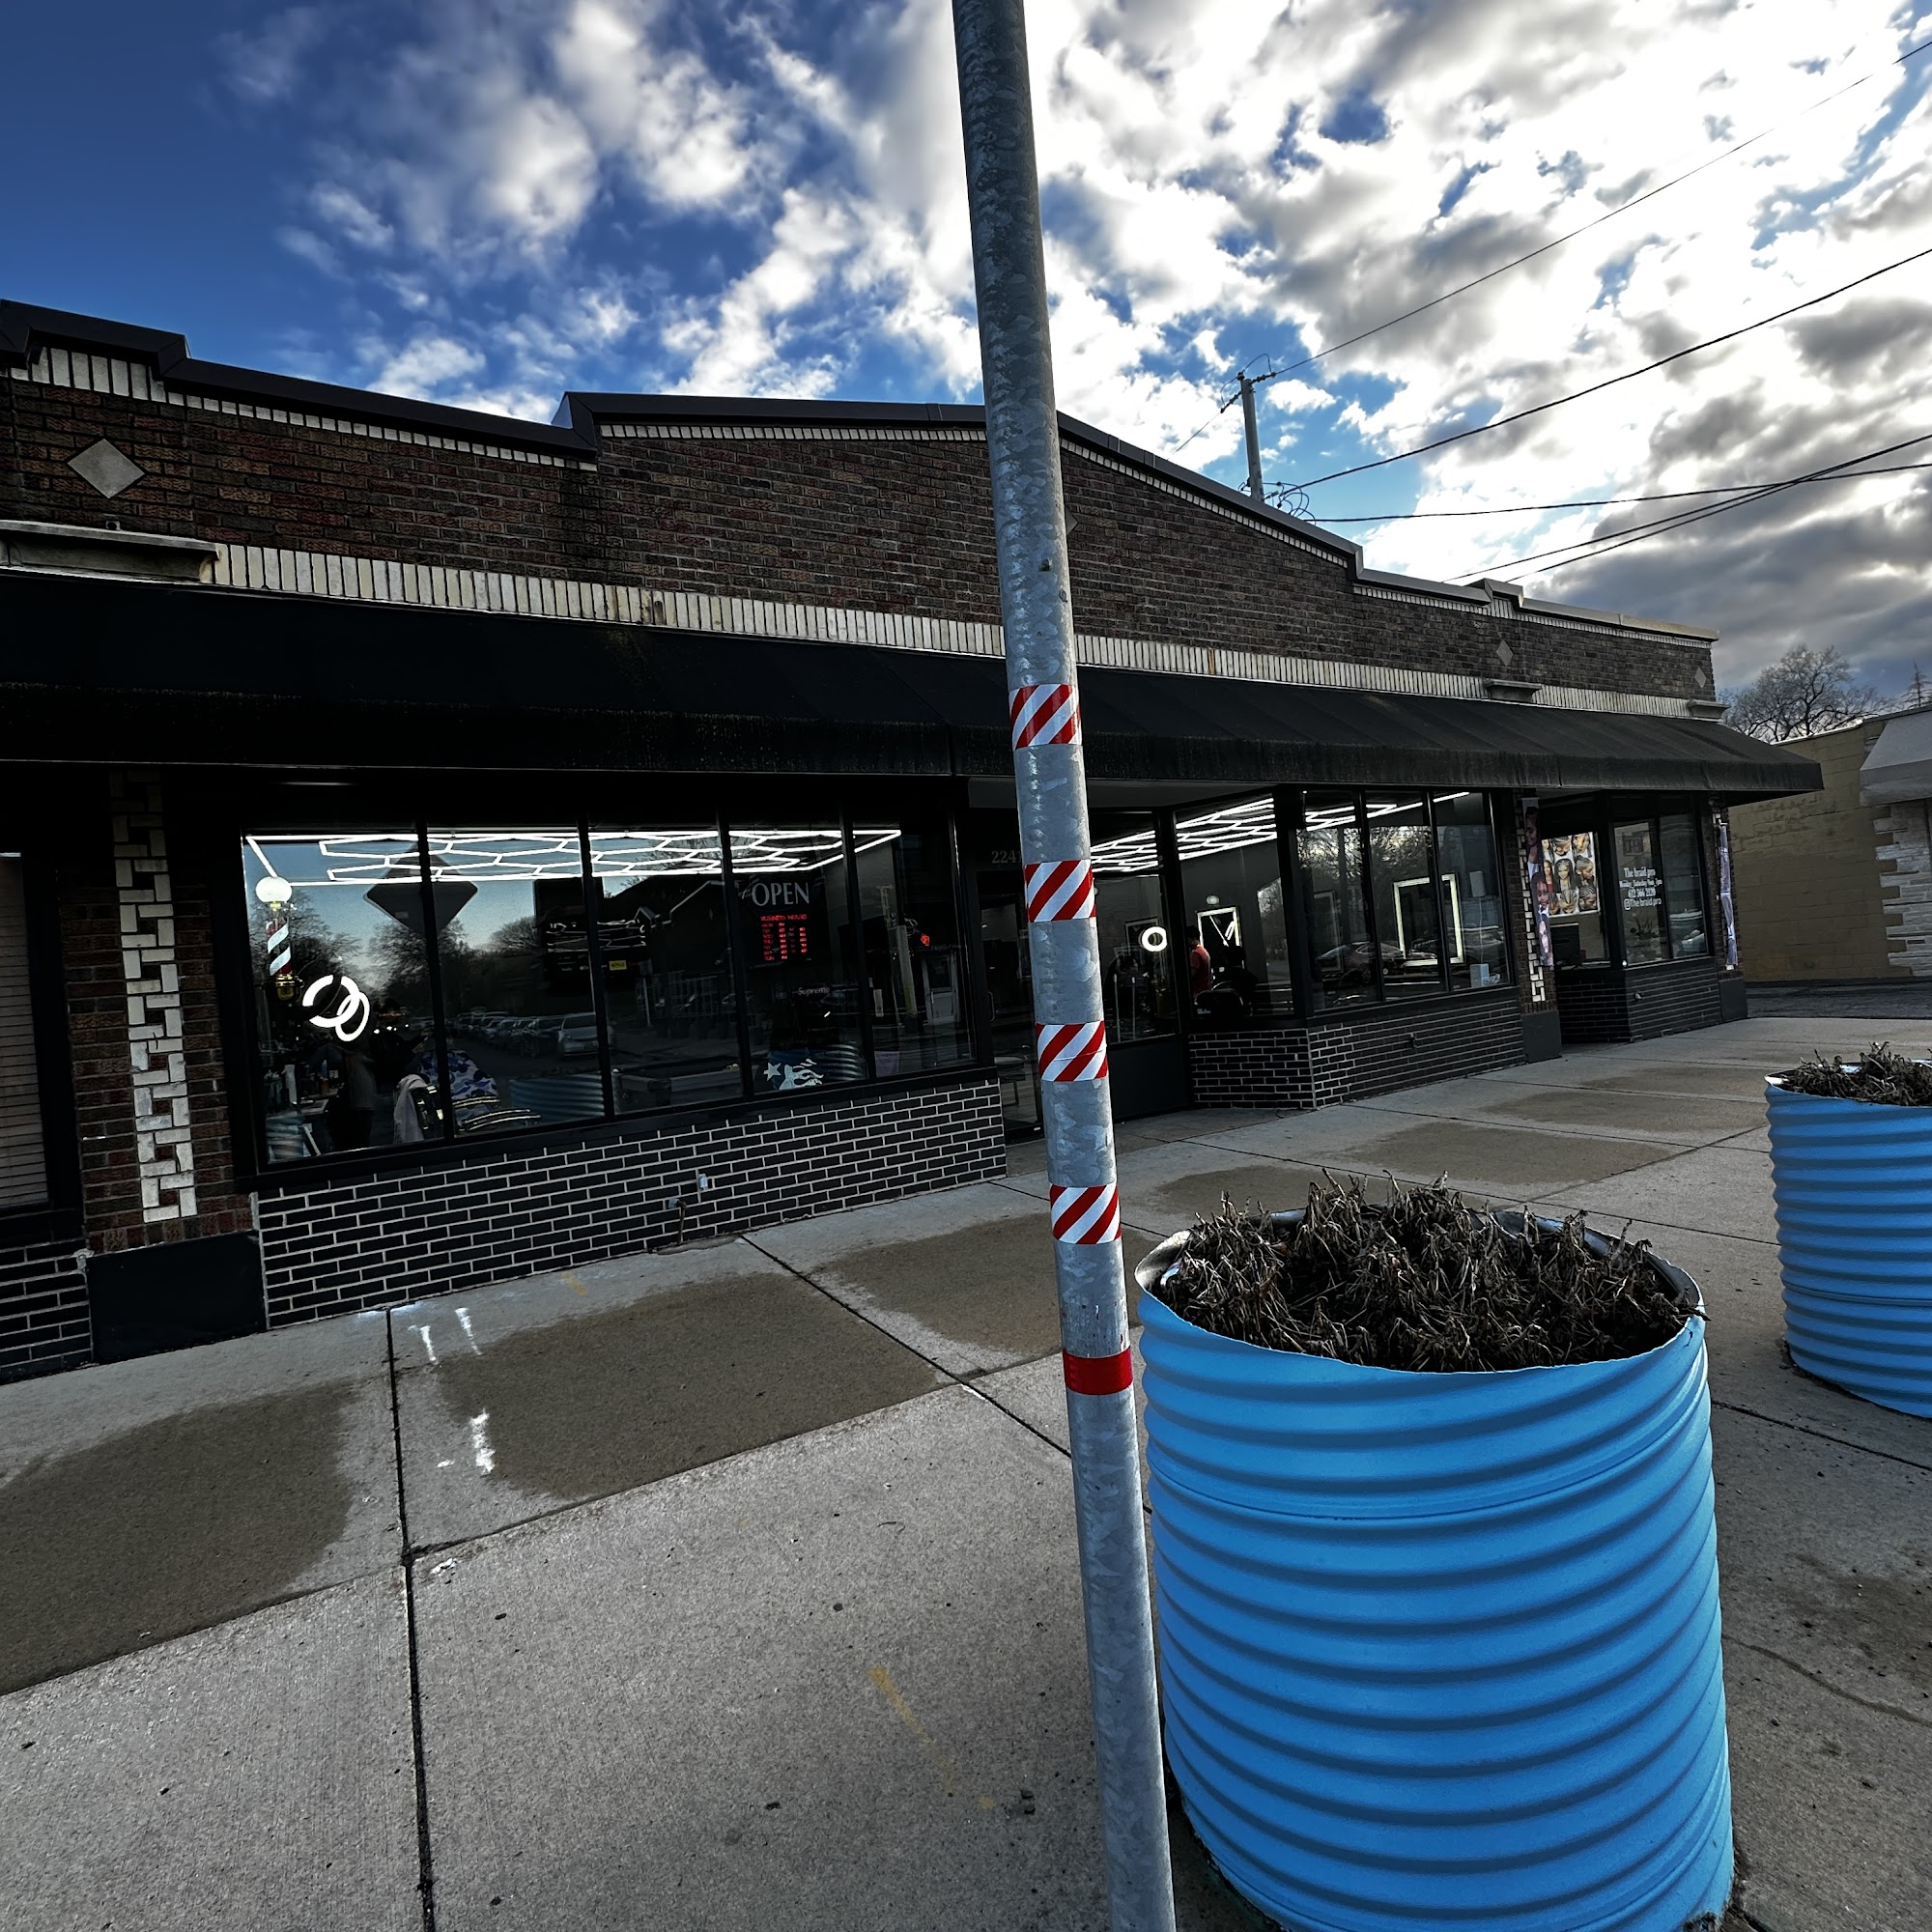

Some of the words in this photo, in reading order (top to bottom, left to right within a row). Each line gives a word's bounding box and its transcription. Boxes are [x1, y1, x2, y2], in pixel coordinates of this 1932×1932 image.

[1624, 867, 1634, 878] The
[1634, 867, 1647, 877] braid
[1647, 868, 1656, 878] pro
[752, 882, 810, 906] OPEN
